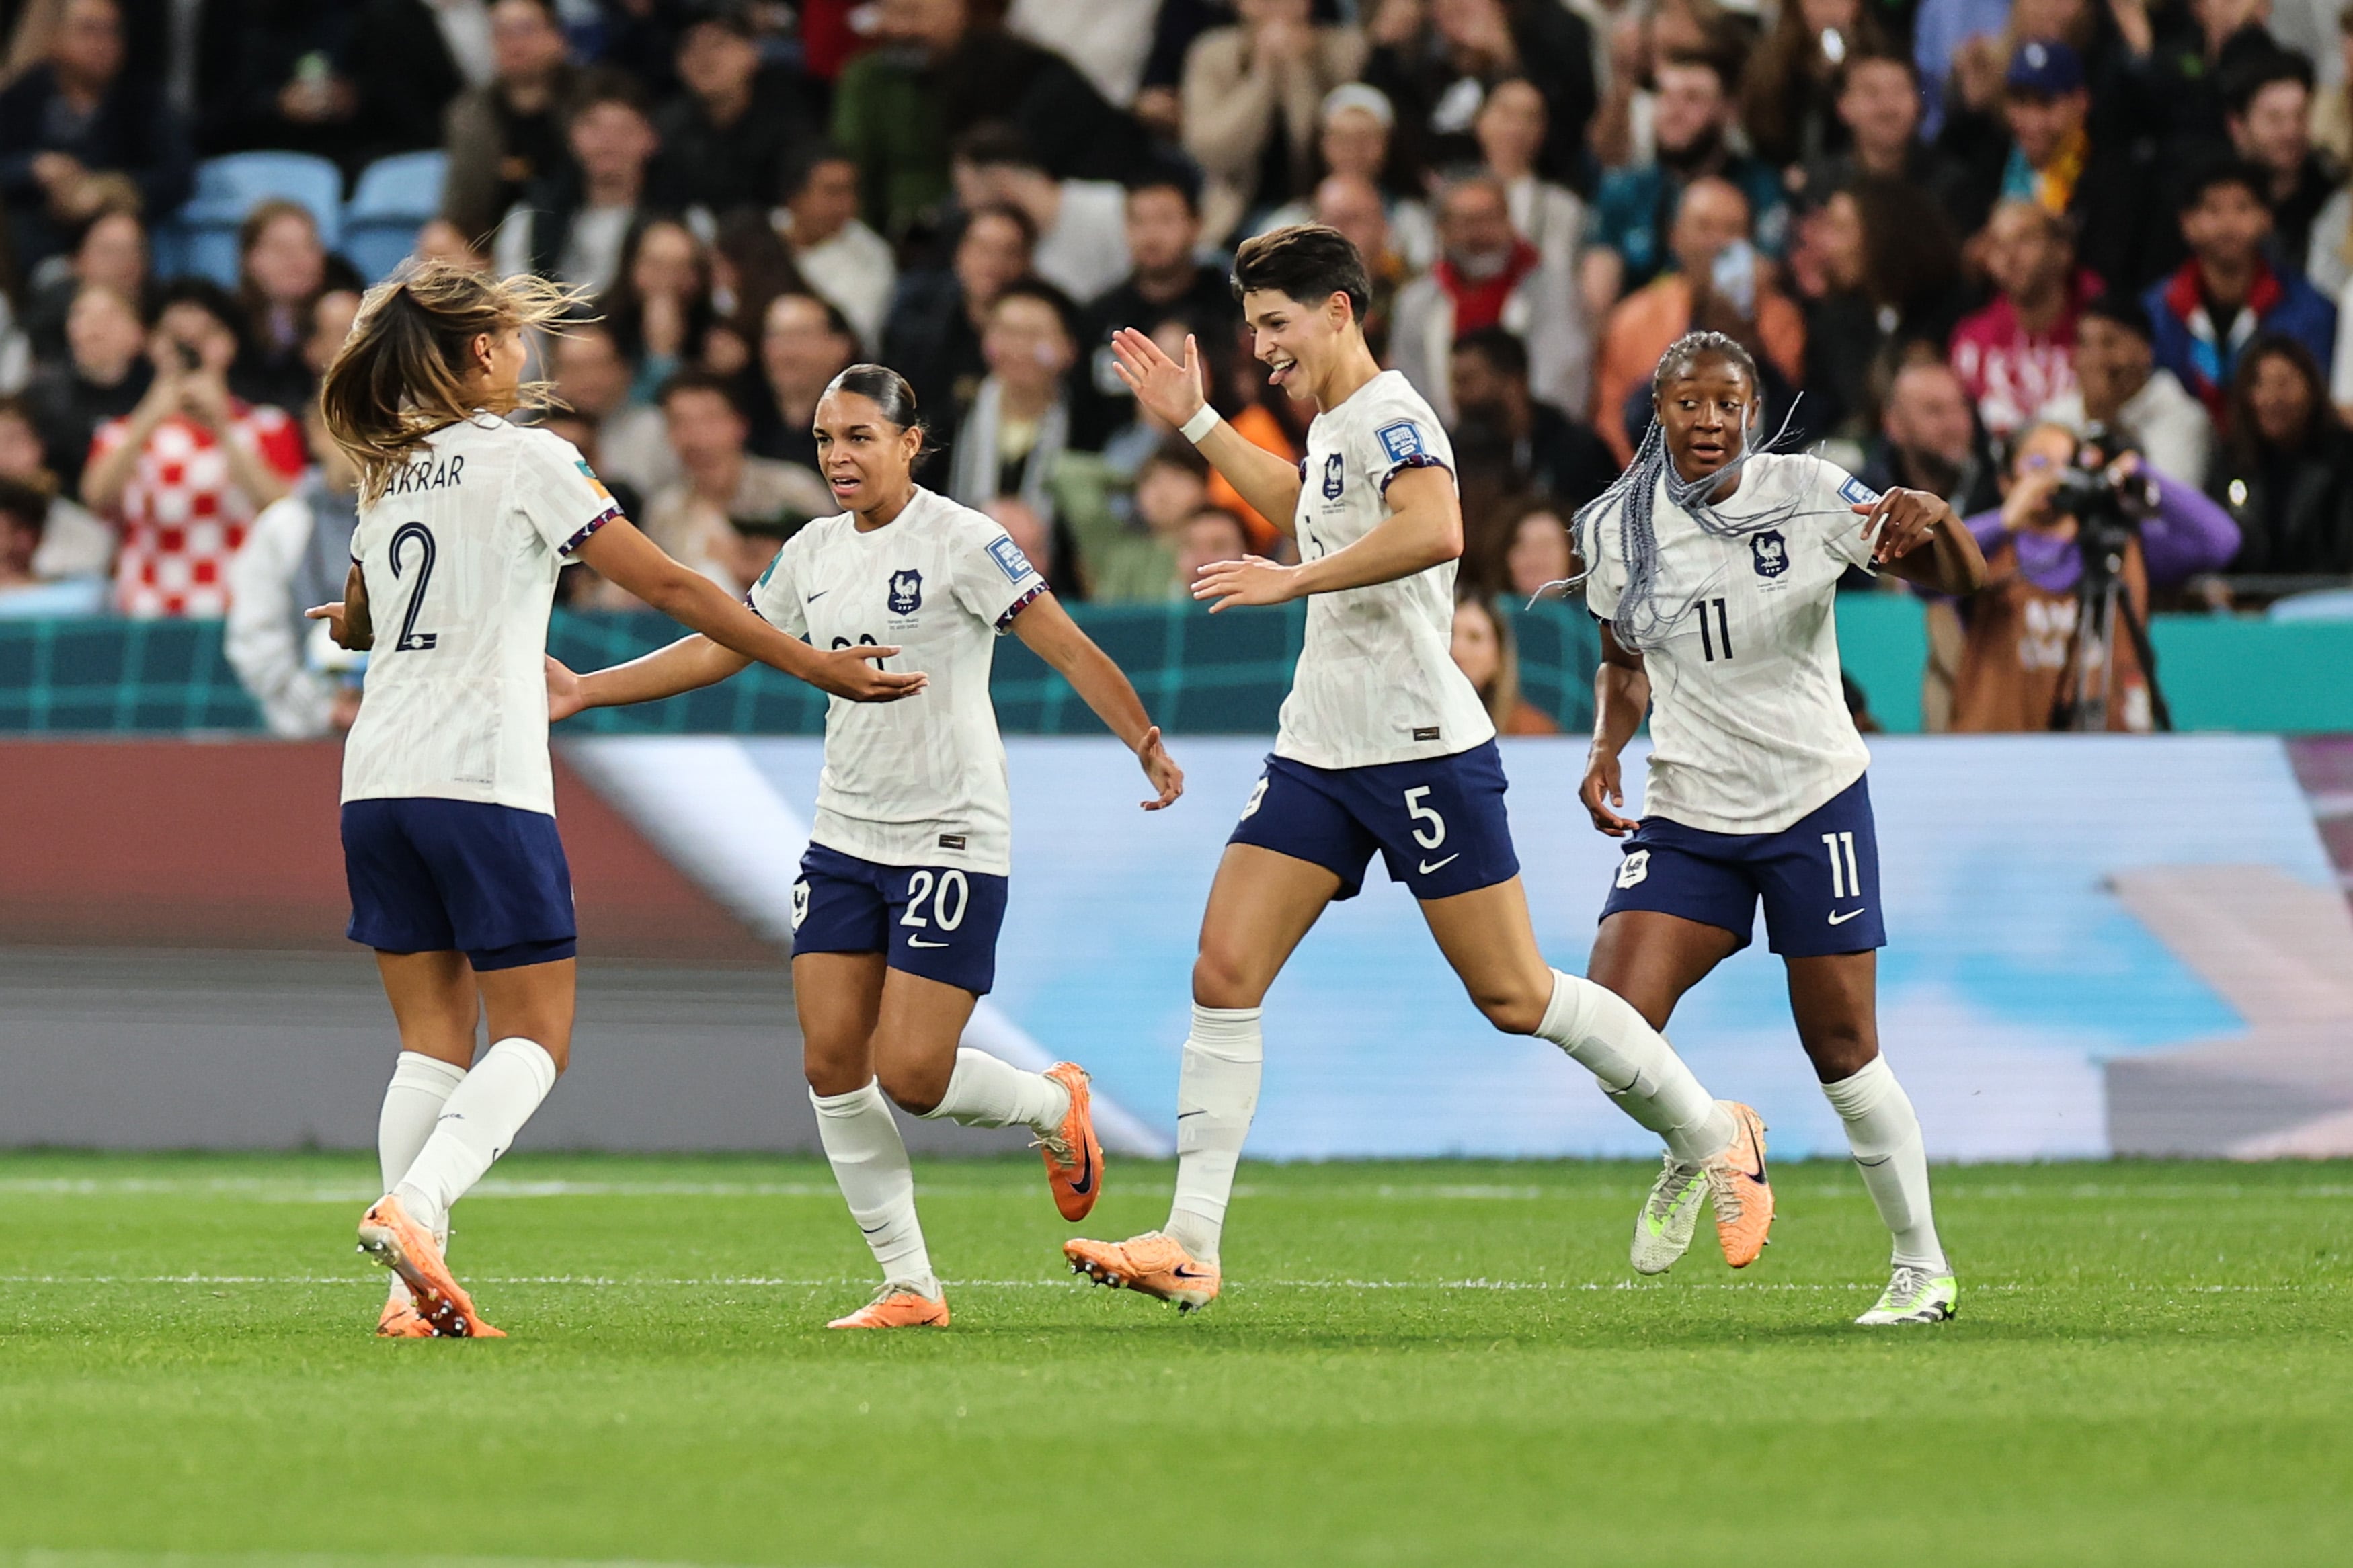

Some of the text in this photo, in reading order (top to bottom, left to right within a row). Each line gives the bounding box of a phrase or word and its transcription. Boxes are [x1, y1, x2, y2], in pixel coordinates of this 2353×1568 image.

[379, 455, 464, 498] AKRAR
[389, 522, 437, 651] 2
[1693, 598, 1733, 662] 11
[1404, 786, 1447, 850] 5
[1821, 831, 1860, 899] 11
[900, 870, 969, 931] 20
